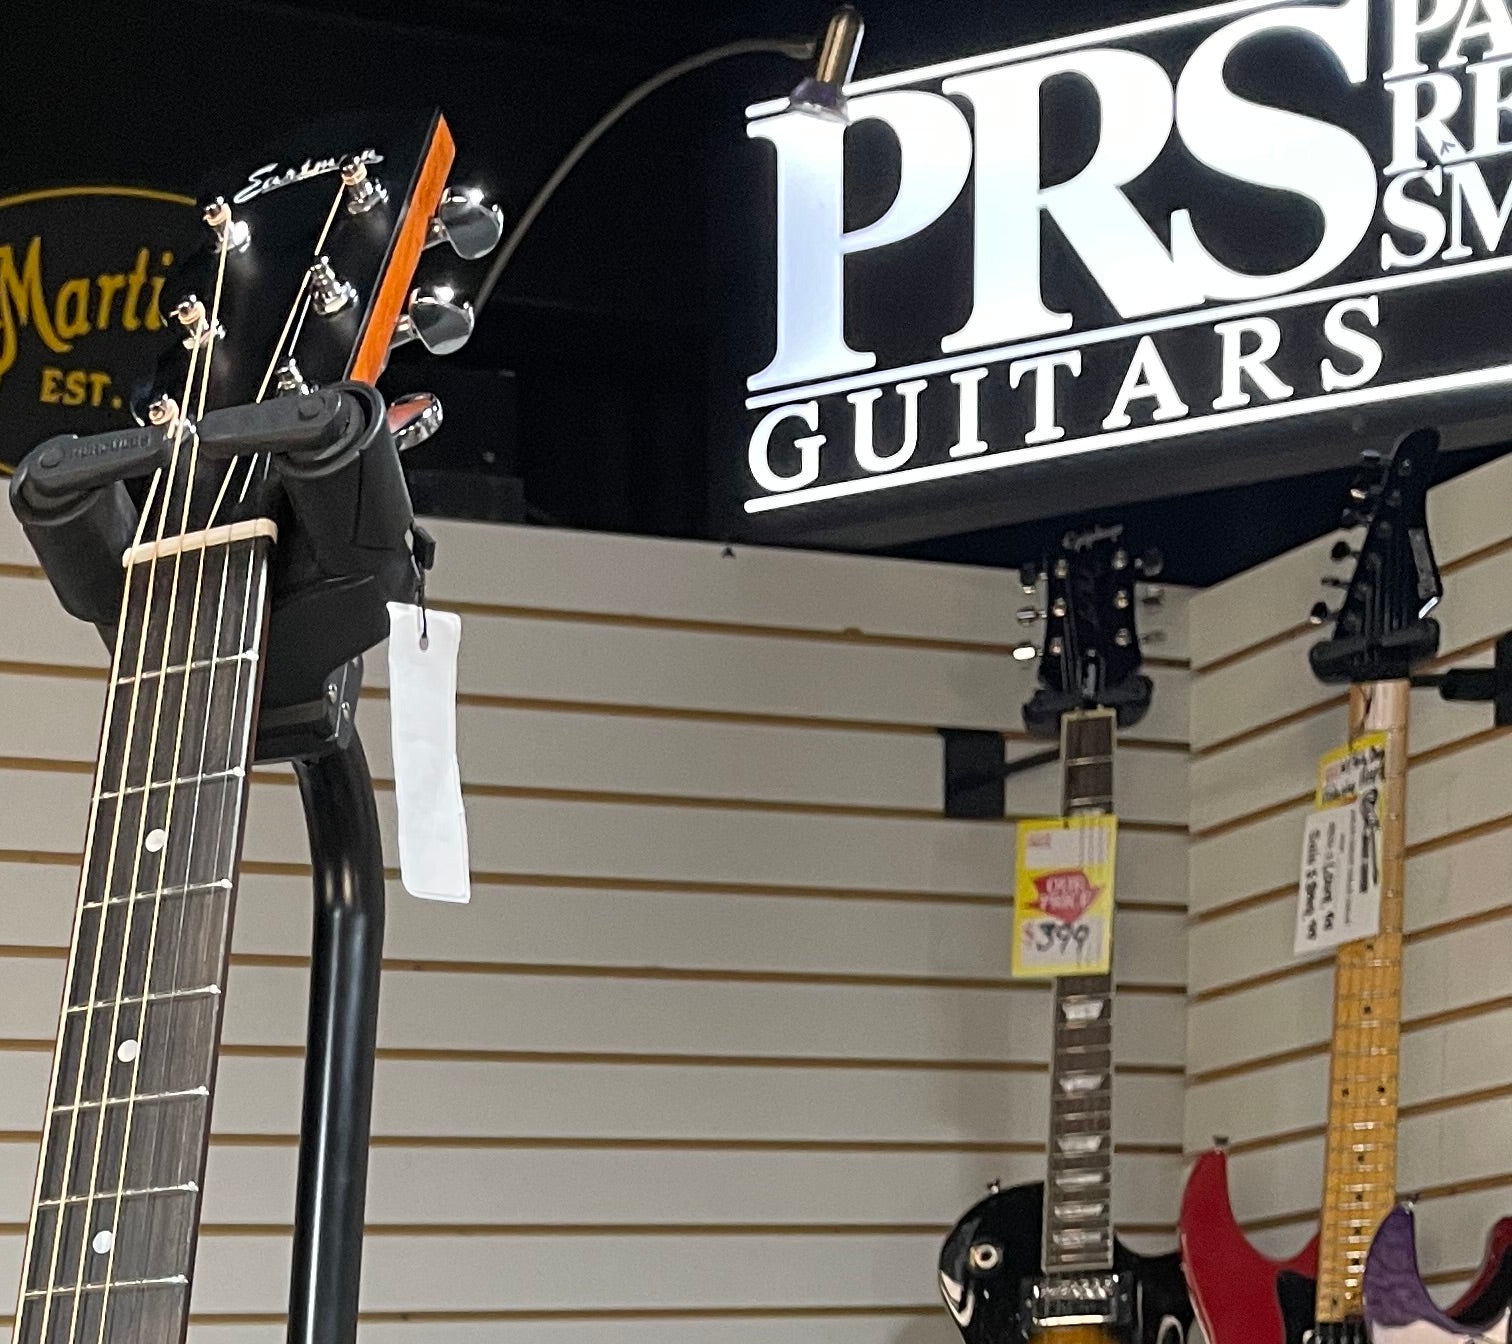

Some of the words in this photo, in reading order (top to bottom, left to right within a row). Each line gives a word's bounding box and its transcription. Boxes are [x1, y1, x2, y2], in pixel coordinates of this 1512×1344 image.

[747, 3, 1377, 392] PRS
[40, 367, 124, 409] EST.
[747, 296, 1384, 493] GUITARS
